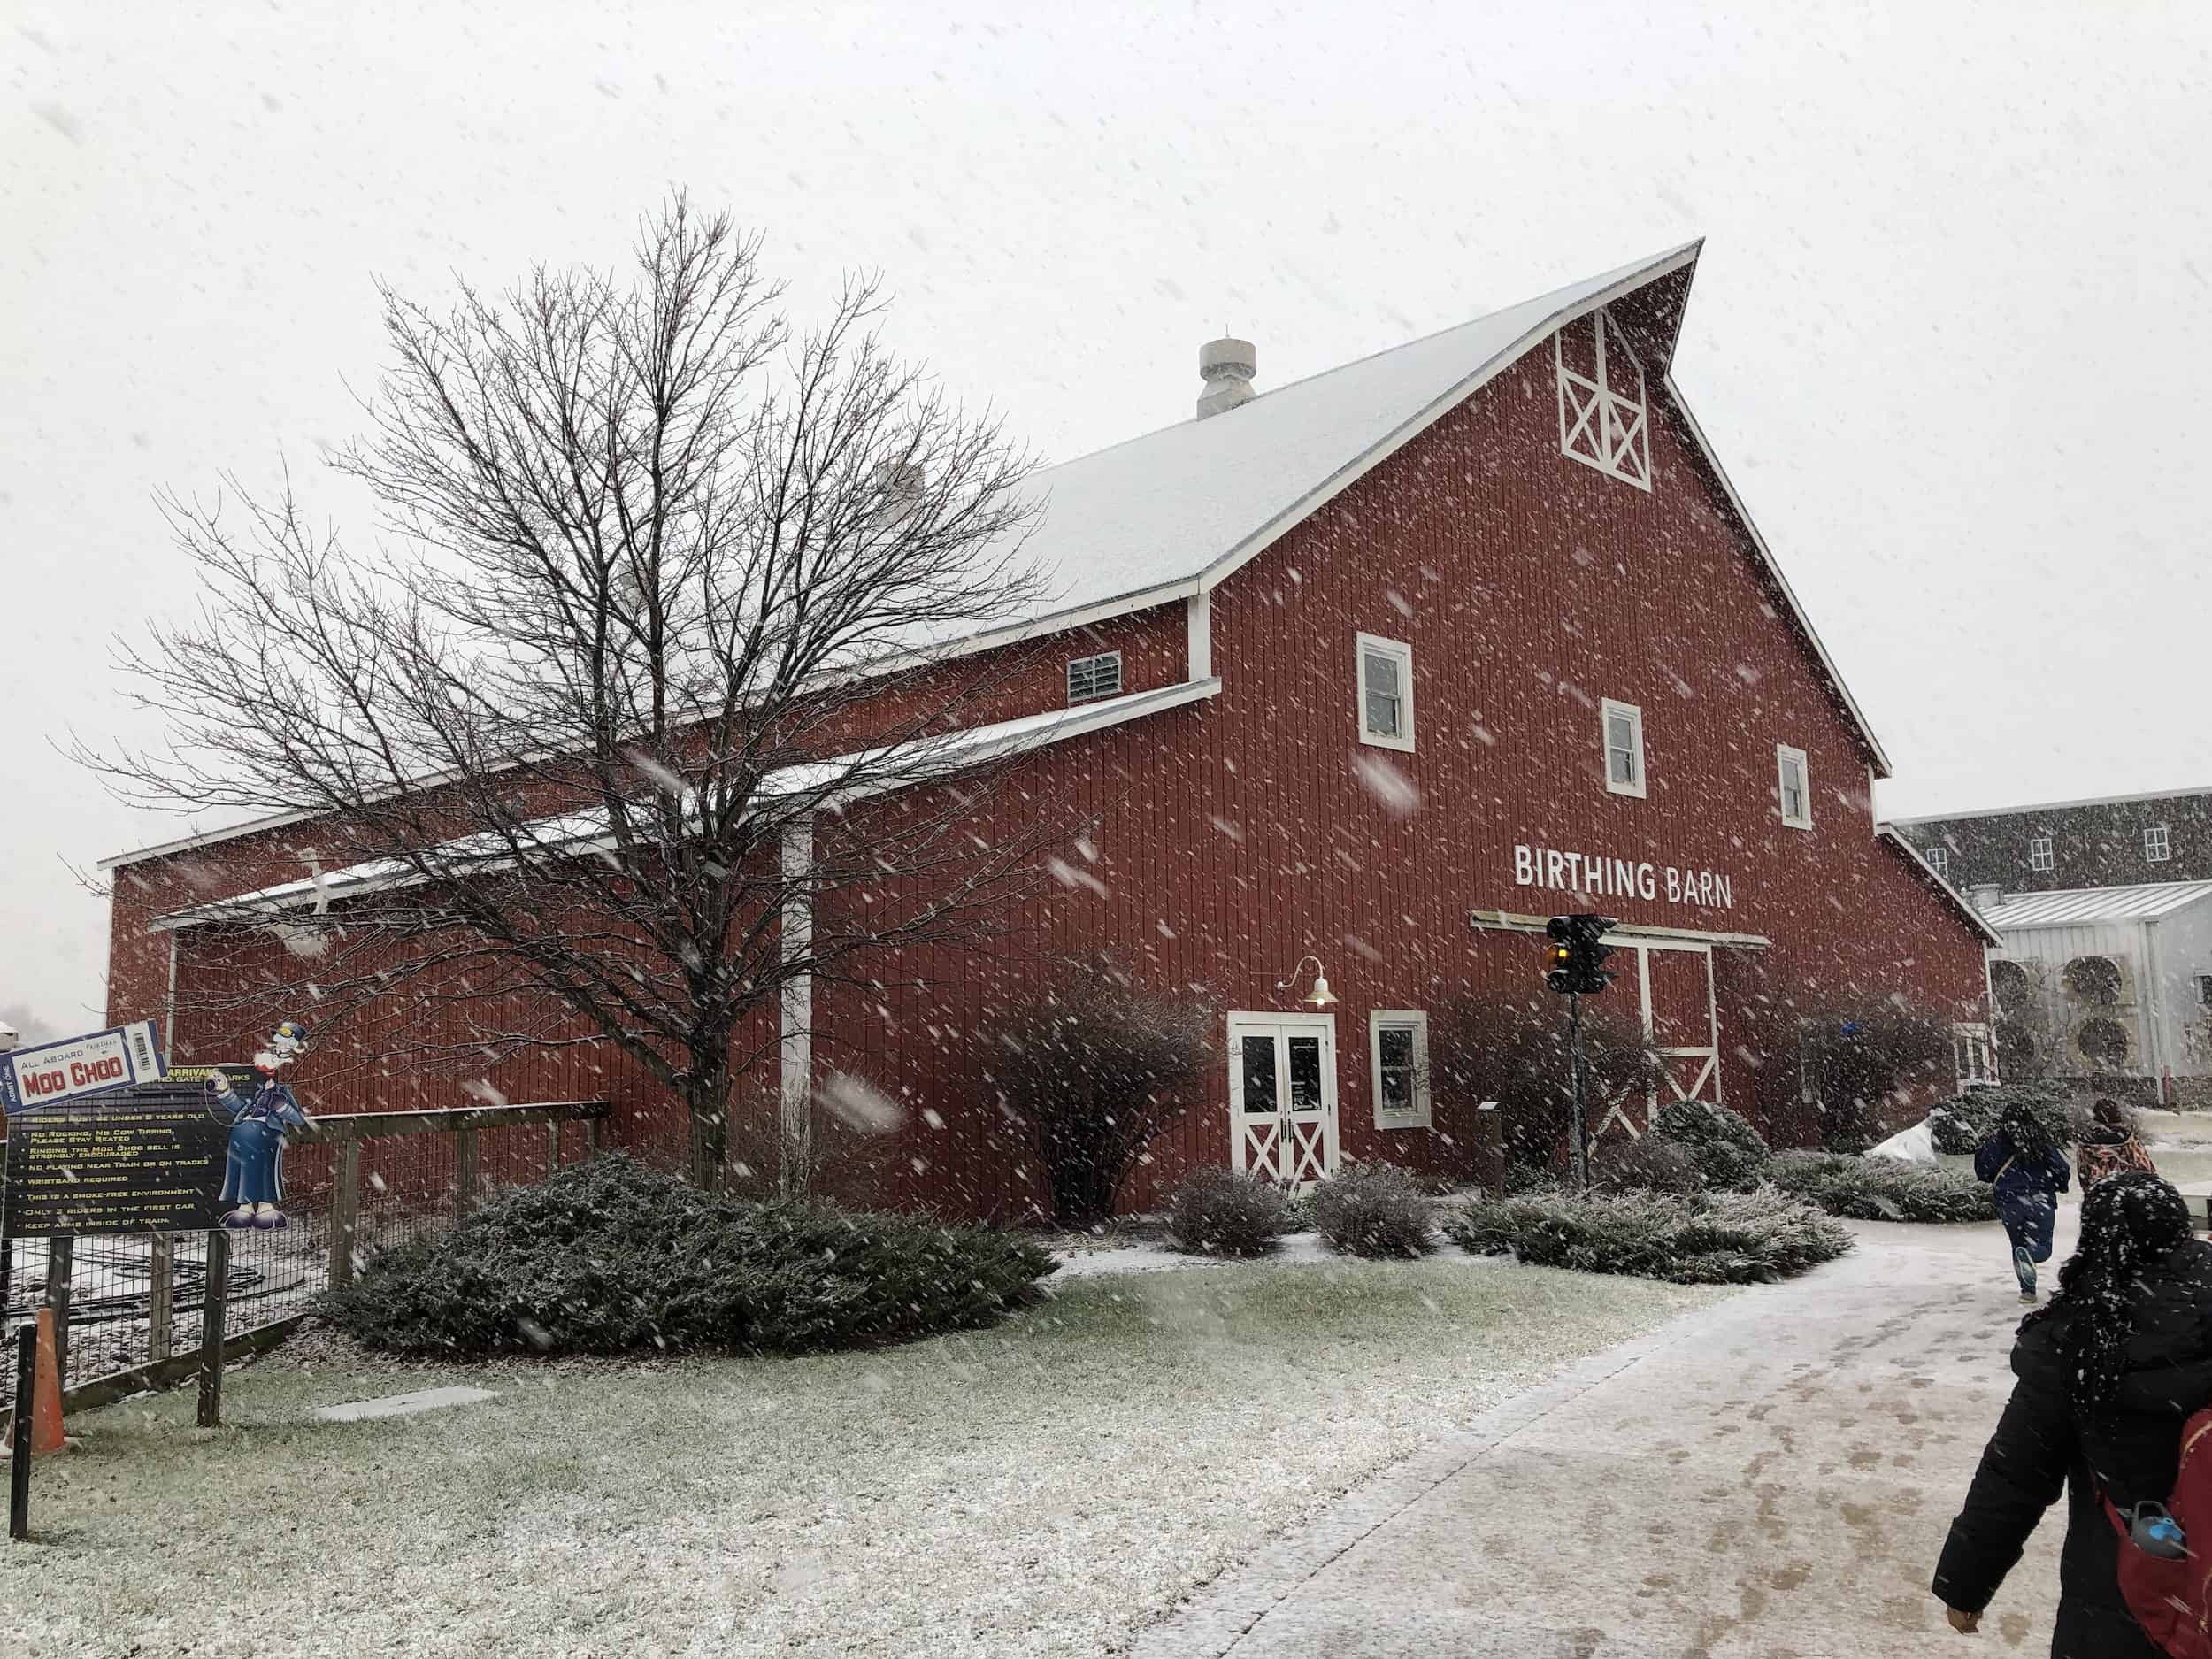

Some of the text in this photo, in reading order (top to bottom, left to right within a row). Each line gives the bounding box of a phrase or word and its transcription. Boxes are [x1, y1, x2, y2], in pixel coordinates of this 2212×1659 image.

[1515, 844, 1732, 909] BIRTHING BARN
[22, 1056, 123, 1097] MOO CHOO
[43, 1050, 84, 1064] ABOARD
